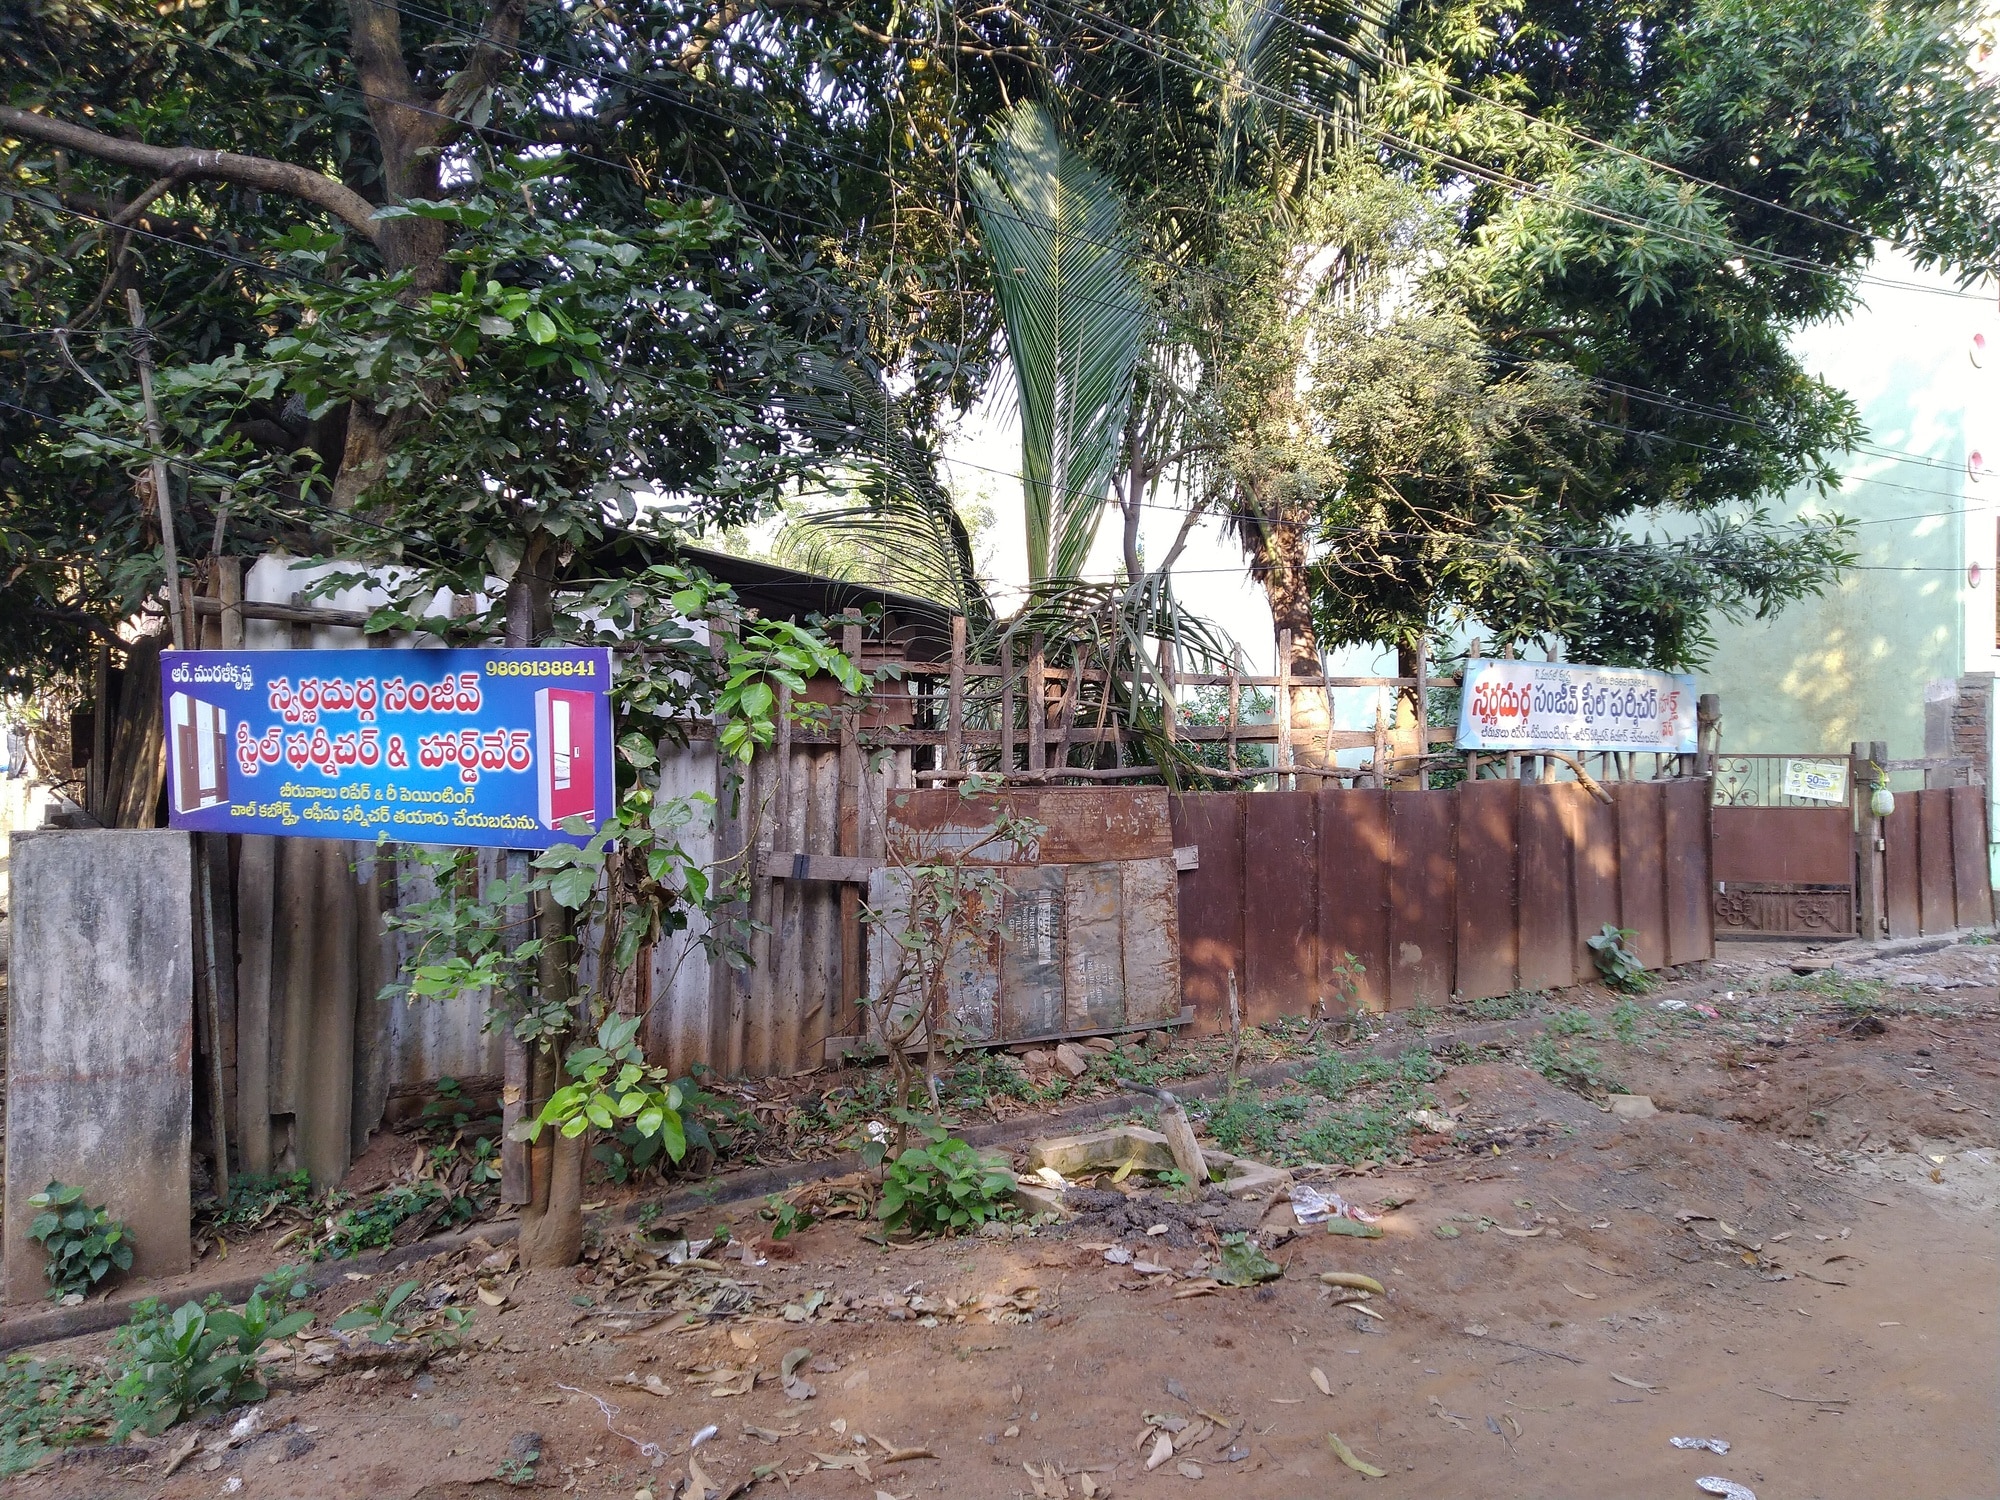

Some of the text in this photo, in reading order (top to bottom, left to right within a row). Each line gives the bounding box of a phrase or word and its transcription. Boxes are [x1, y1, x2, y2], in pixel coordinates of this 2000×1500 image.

[485, 660, 596, 677] 9866138841
[268, 673, 483, 723] స్వర్ణదుర్గ సంజీవ్
[1472, 681, 1532, 726] స్వర్ణదుర్గ
[1534, 682, 1579, 715] సంజీవ్
[1581, 681, 1609, 724] స్టీల్
[236, 723, 284, 774] స్టీల్
[286, 728, 380, 775] ఫర్నీచర్
[388, 736, 409, 767] &
[279, 782, 337, 799] బీరువాలు
[340, 783, 371, 800] రిపేర్
[374, 789, 384, 801] &
[399, 785, 475, 804] పెయింటింగ్
[230, 801, 257, 817] వాల్
[303, 802, 340, 822] ఆఫీసు
[393, 809, 449, 826] తయారు
